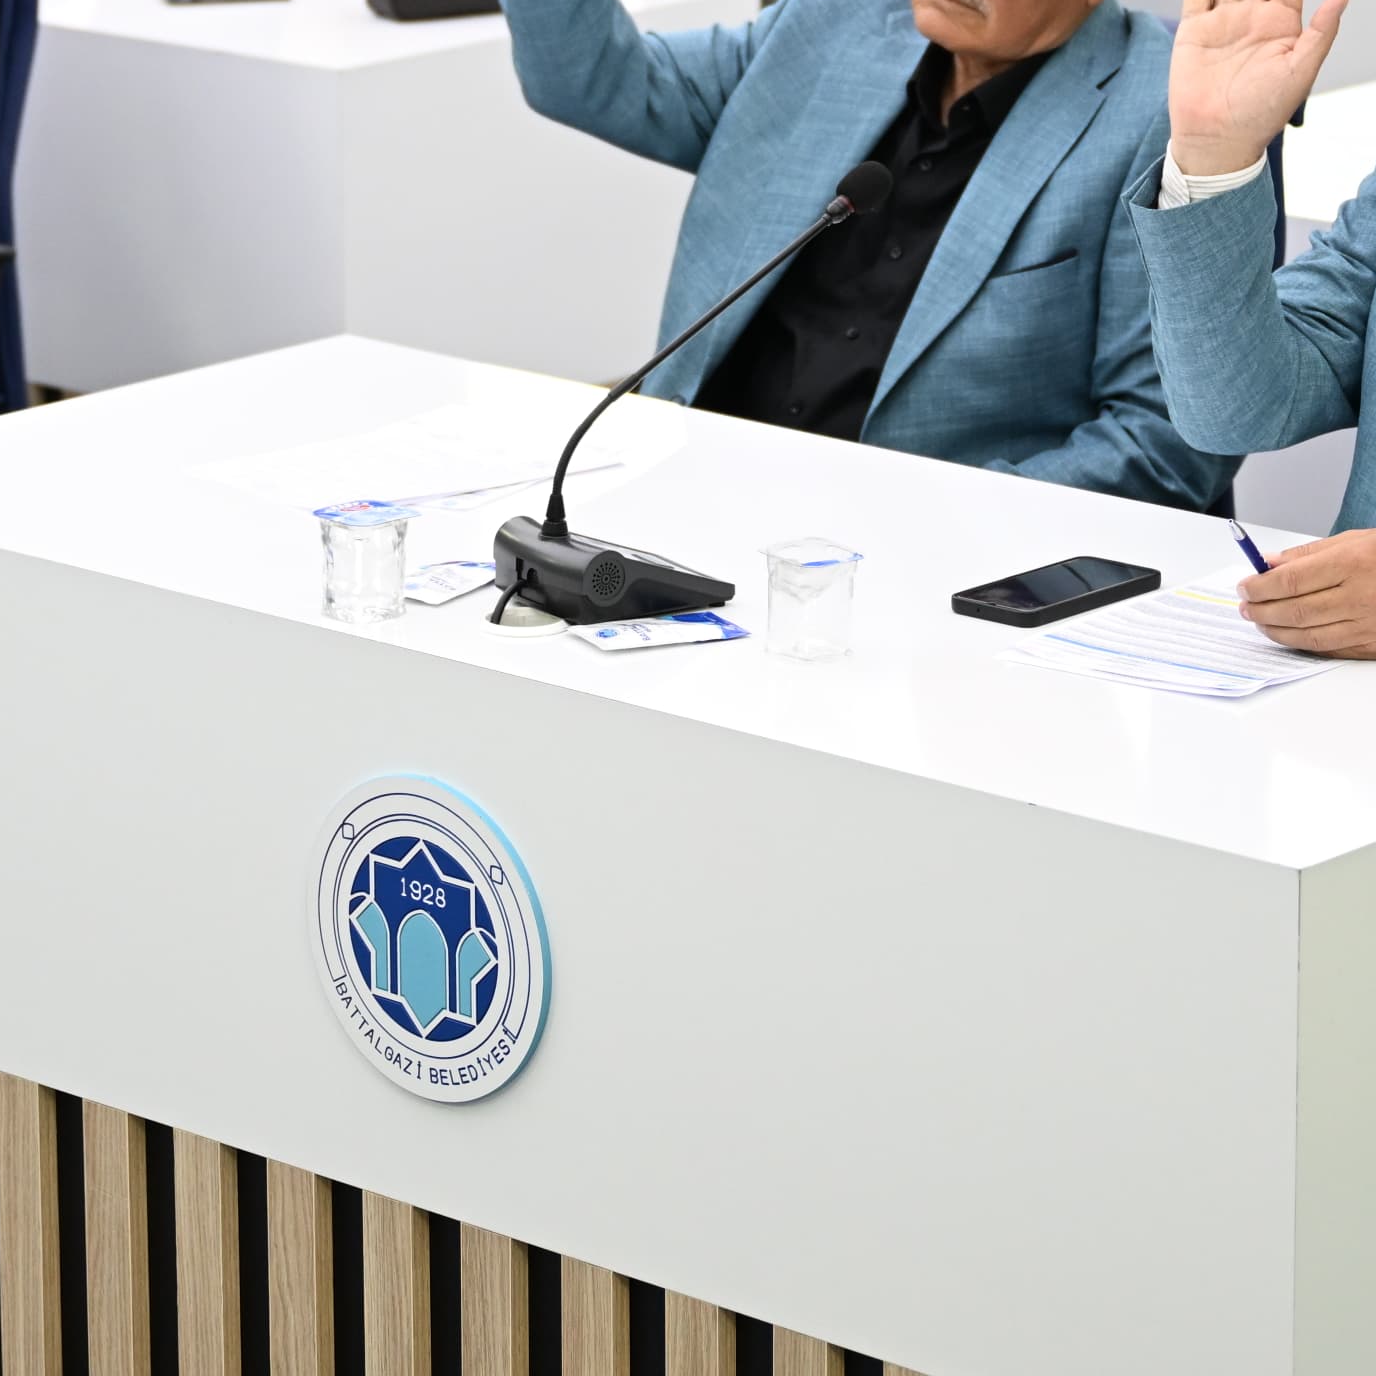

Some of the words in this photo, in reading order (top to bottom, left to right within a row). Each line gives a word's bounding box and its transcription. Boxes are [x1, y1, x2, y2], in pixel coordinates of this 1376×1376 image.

[400, 877, 447, 909] 1928
[335, 982, 422, 1080] BATTALGAZİ
[429, 1028, 517, 1086] BELEDİYESİ
